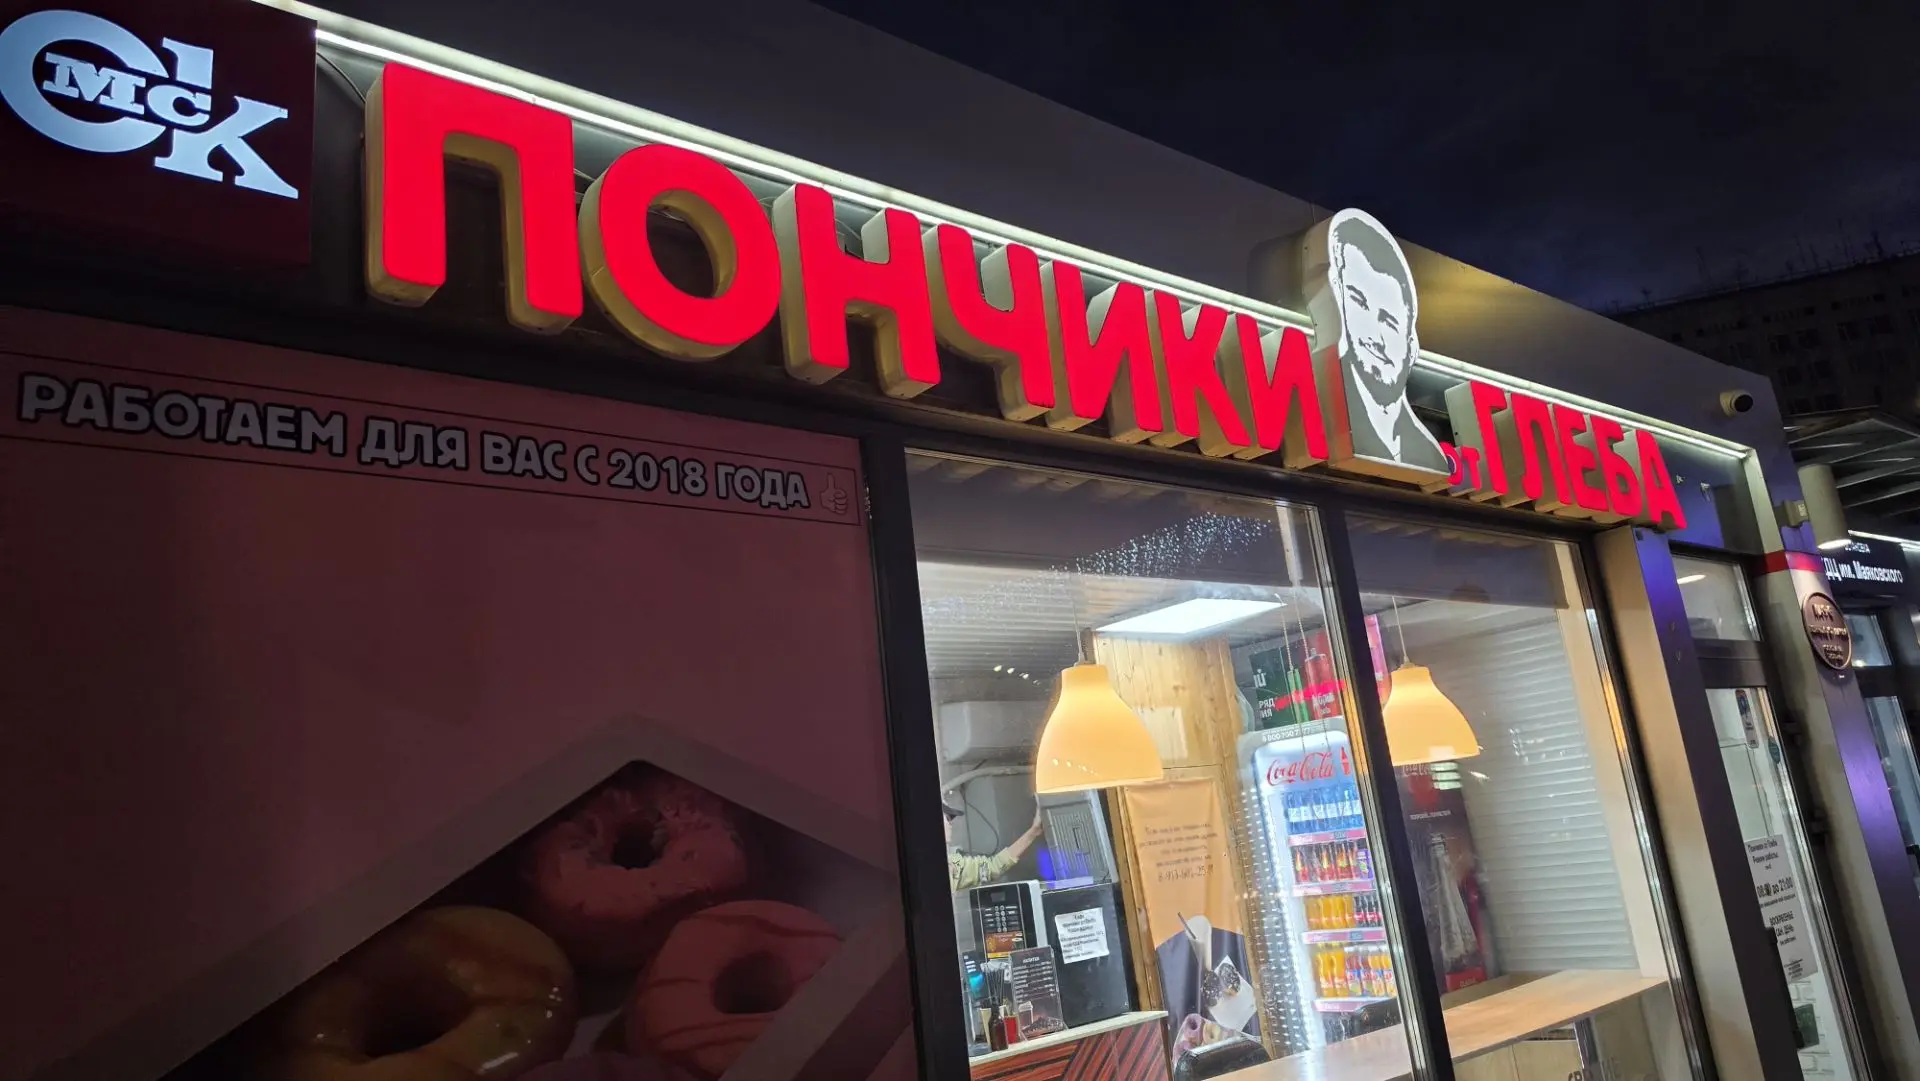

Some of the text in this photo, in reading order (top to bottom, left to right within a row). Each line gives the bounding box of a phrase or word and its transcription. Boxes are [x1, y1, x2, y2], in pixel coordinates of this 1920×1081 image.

[381, 61, 1329, 460] ПОНЧИКИ
[1469, 380, 1688, 529] ГЛЕБА
[20, 373, 810, 509] РАБОТАЕМ ДЛЯ ВАС С 2018 ГОДА
[1853, 560, 1904, 583] Маяковского
